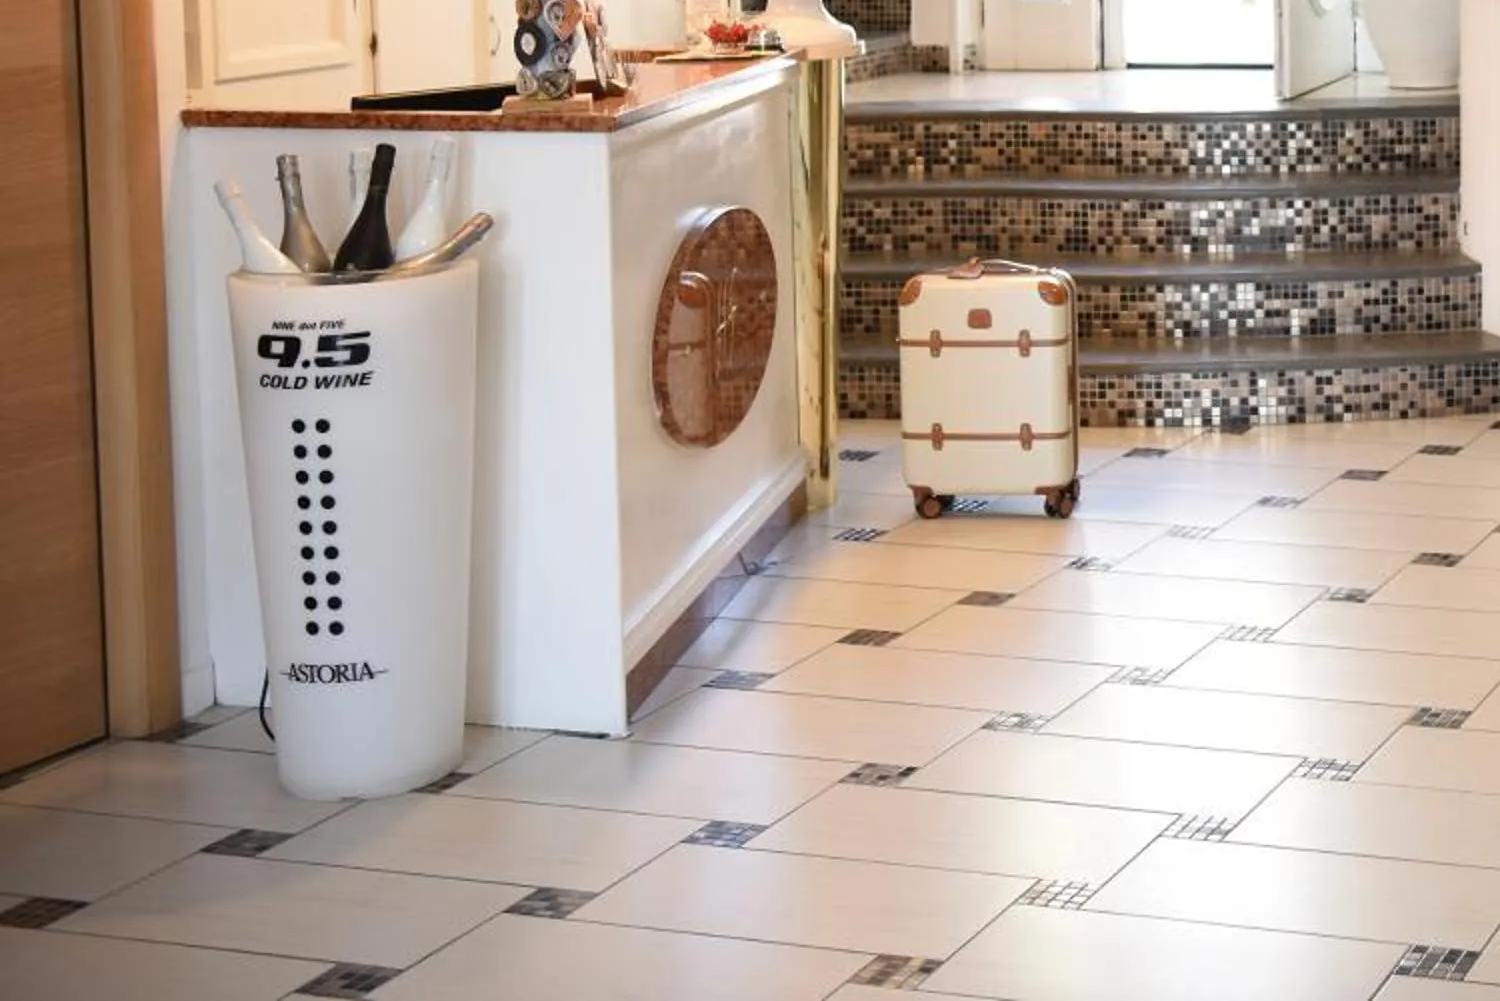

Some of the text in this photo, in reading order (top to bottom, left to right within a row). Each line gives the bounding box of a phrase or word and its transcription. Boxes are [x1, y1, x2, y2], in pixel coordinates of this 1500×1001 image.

[320, 318, 345, 329] FIVE
[257, 331, 371, 369] 9.5
[259, 370, 374, 390] COLD WINE
[287, 661, 375, 684] ASTORIA
